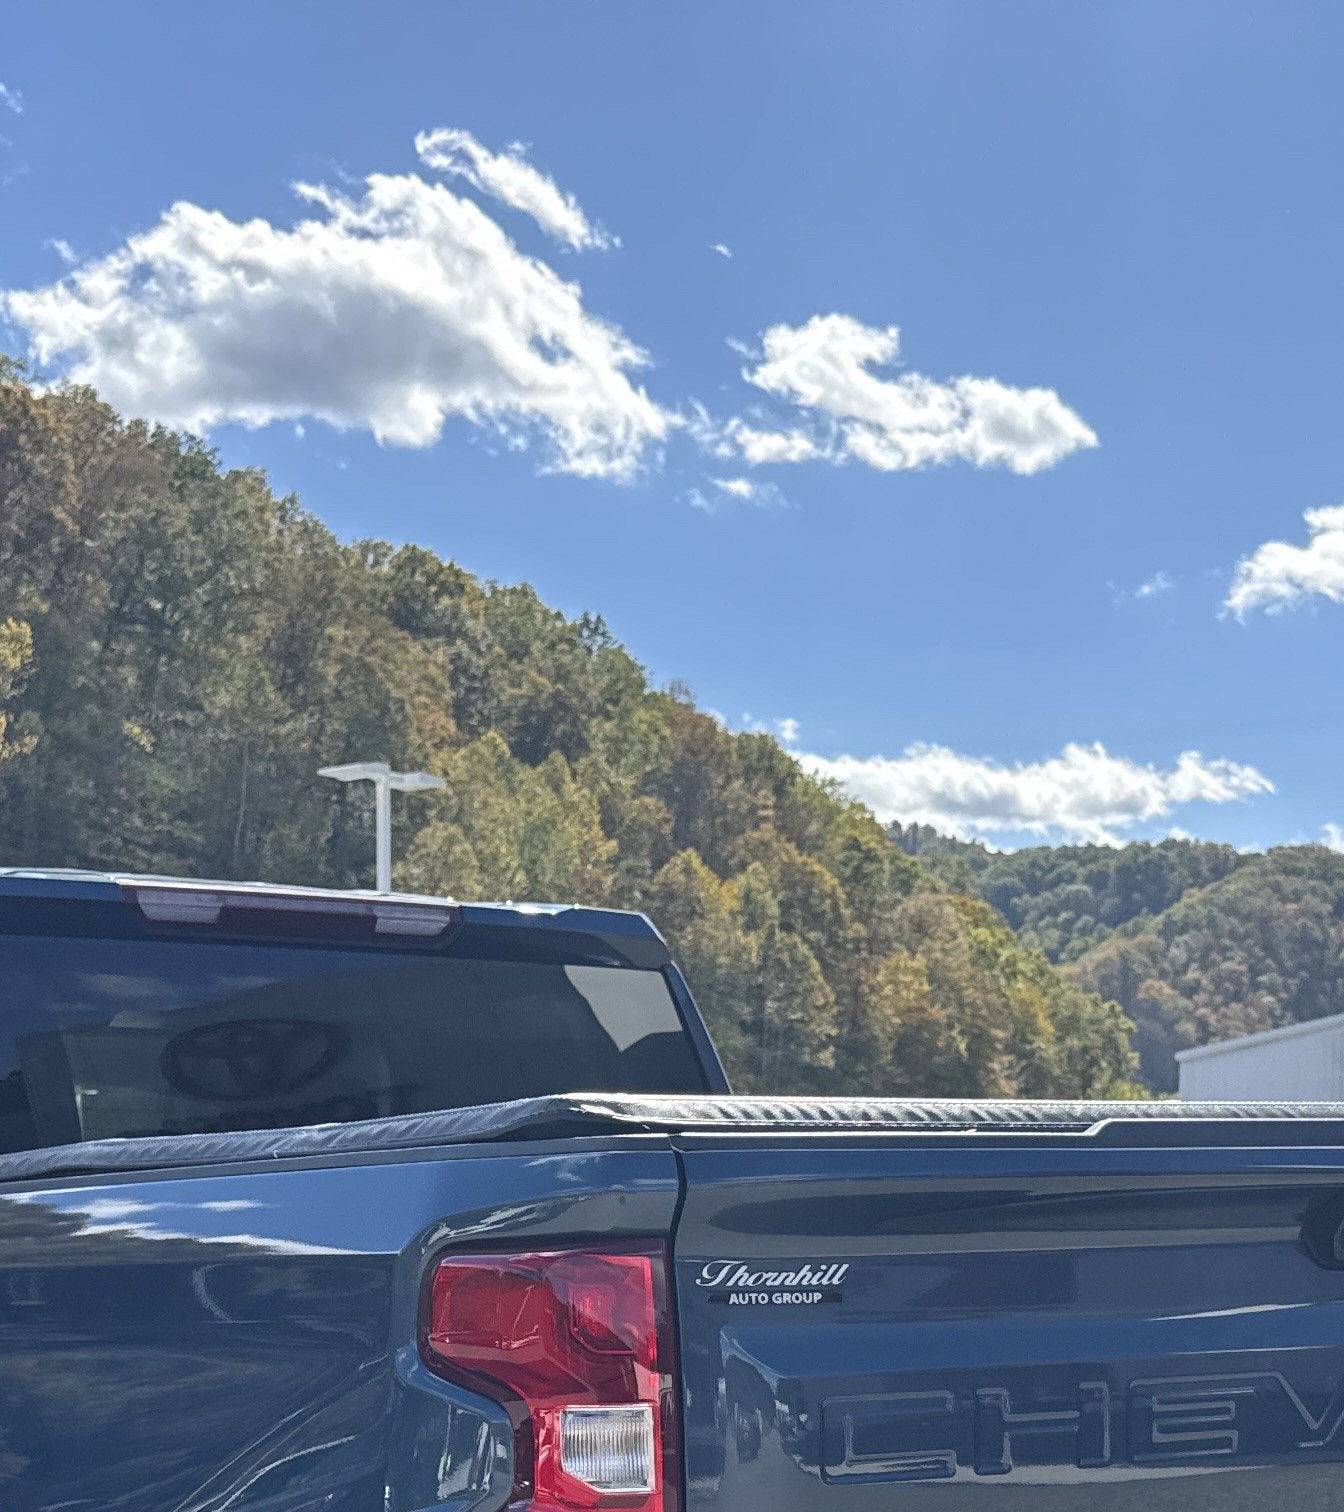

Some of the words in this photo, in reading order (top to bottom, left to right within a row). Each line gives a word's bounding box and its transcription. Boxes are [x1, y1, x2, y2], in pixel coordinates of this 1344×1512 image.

[695, 1259, 850, 1287] Thornhill
[728, 1292, 769, 1305] AUTO
[771, 1292, 823, 1305] GROUP
